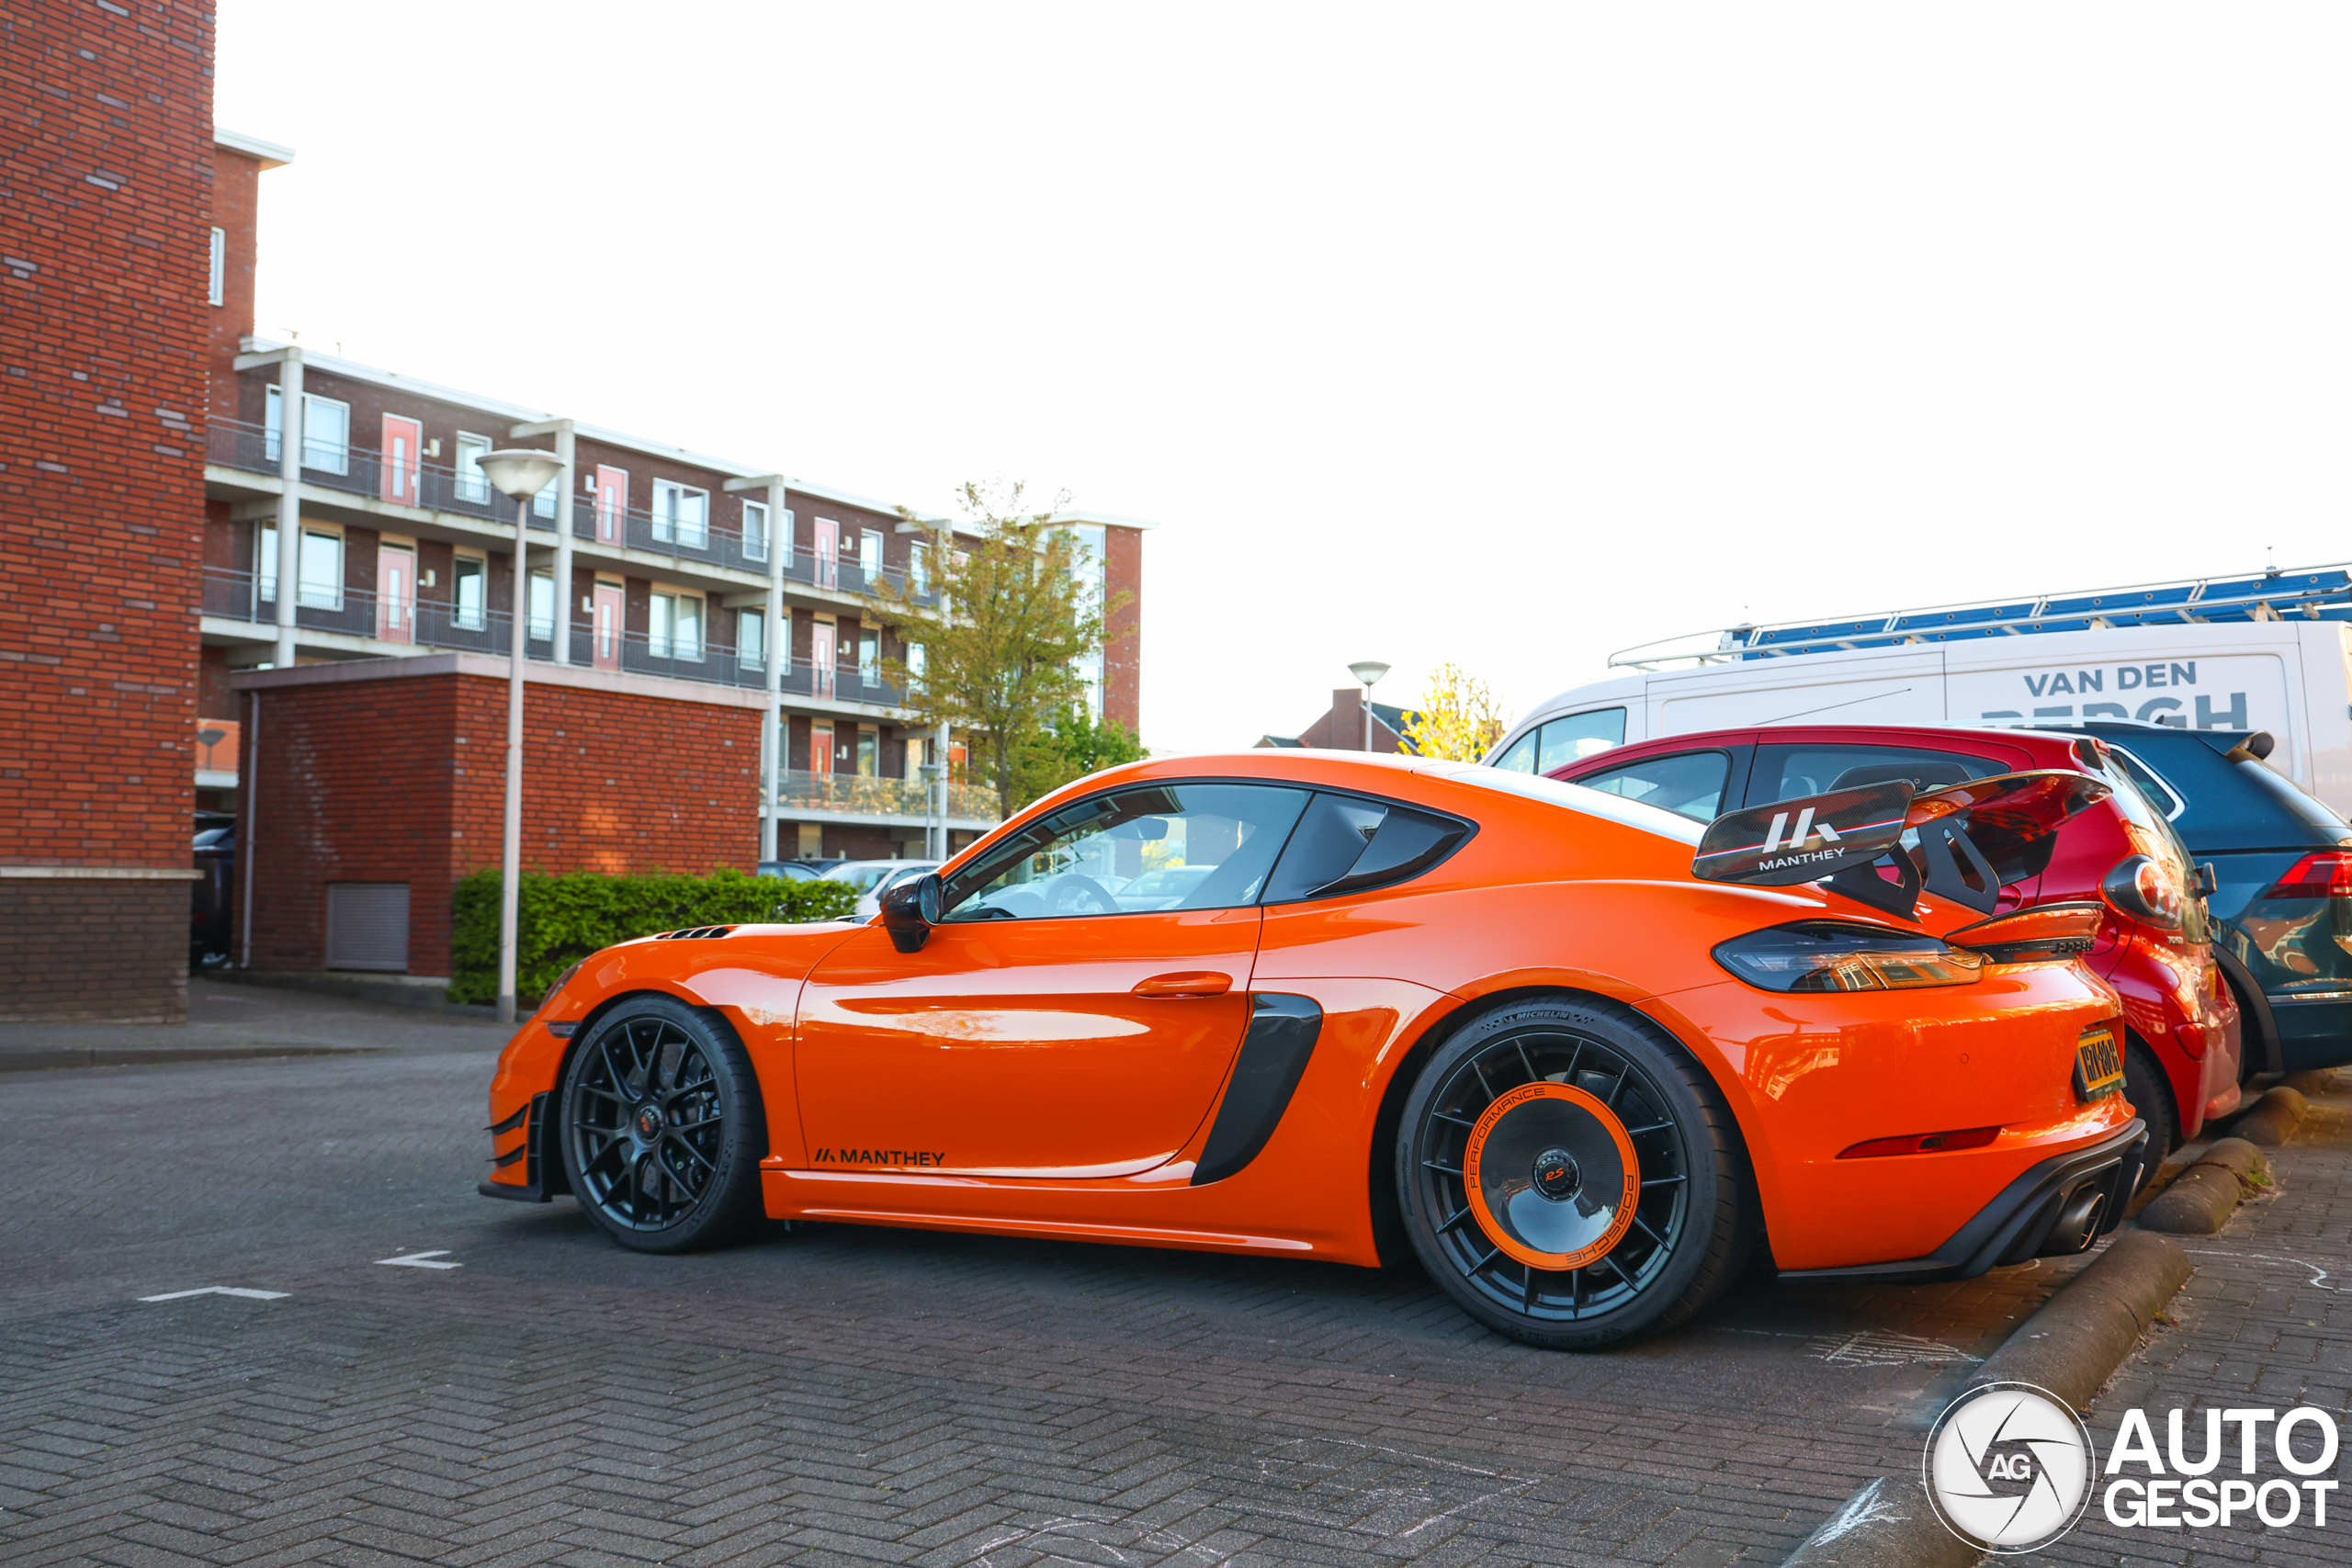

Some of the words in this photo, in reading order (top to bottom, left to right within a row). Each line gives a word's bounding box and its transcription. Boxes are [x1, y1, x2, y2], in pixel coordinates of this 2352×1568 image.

[2024, 669, 2103, 697] VAN
[2117, 660, 2197, 691] DEN
[1758, 847, 1846, 872] MANTHEY
[1516, 1010, 1569, 1021] MICHELIN
[1469, 1088, 1546, 1189] PERFORMANCE
[840, 1148, 945, 1167] MANTHEY
[1544, 1167, 1565, 1182] RS
[1566, 1174, 1634, 1264] PORSCHE
